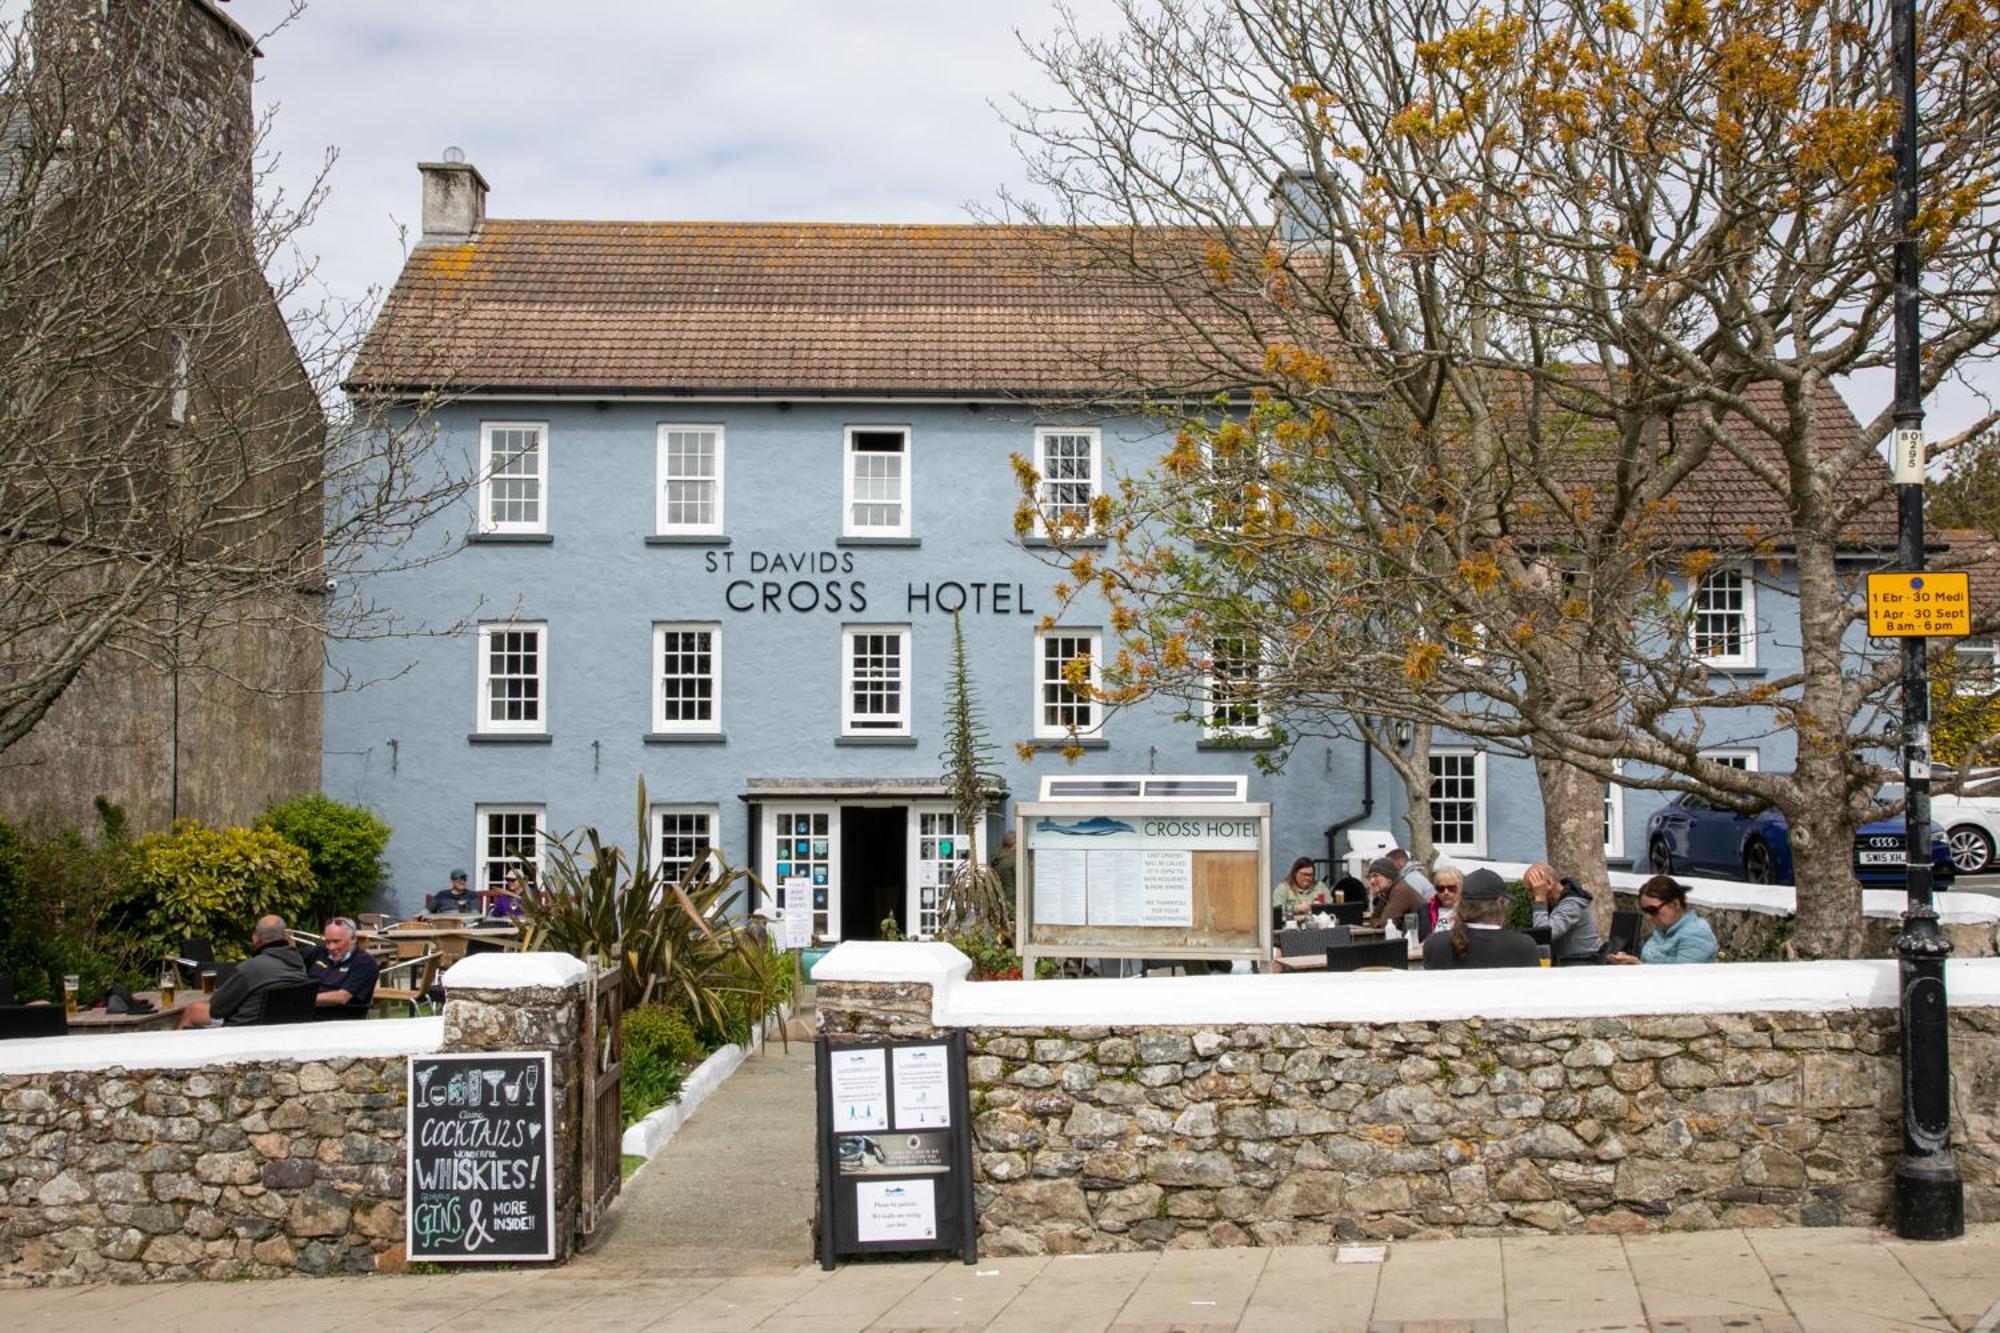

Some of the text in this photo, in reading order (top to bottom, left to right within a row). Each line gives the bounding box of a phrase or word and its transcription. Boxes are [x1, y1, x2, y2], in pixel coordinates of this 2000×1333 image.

[706, 551, 854, 573] ST DAVIDS
[726, 580, 1034, 614] CROSS HOTEL
[1873, 593, 1878, 602] 1
[1882, 593, 1903, 602] Ebr
[1913, 592, 1930, 602] 30
[1935, 592, 1964, 602] Medi
[1874, 610, 1878, 619] 1
[1883, 610, 1904, 620] Apr
[1914, 609, 1931, 618] 30
[1935, 609, 1964, 619] Sept
[1886, 622, 1894, 631] 8
[1897, 623, 1914, 631] am
[1924, 621, 1931, 630] 6
[1935, 622, 1952, 631] pm
[1144, 822, 1259, 838] CROSS HOTEL
[421, 1118, 526, 1147] COCKTAILS
[415, 1156, 540, 1191] WHISKIES!
[493, 1200, 528, 1215] MORE
[414, 1197, 495, 1251] GINS &
